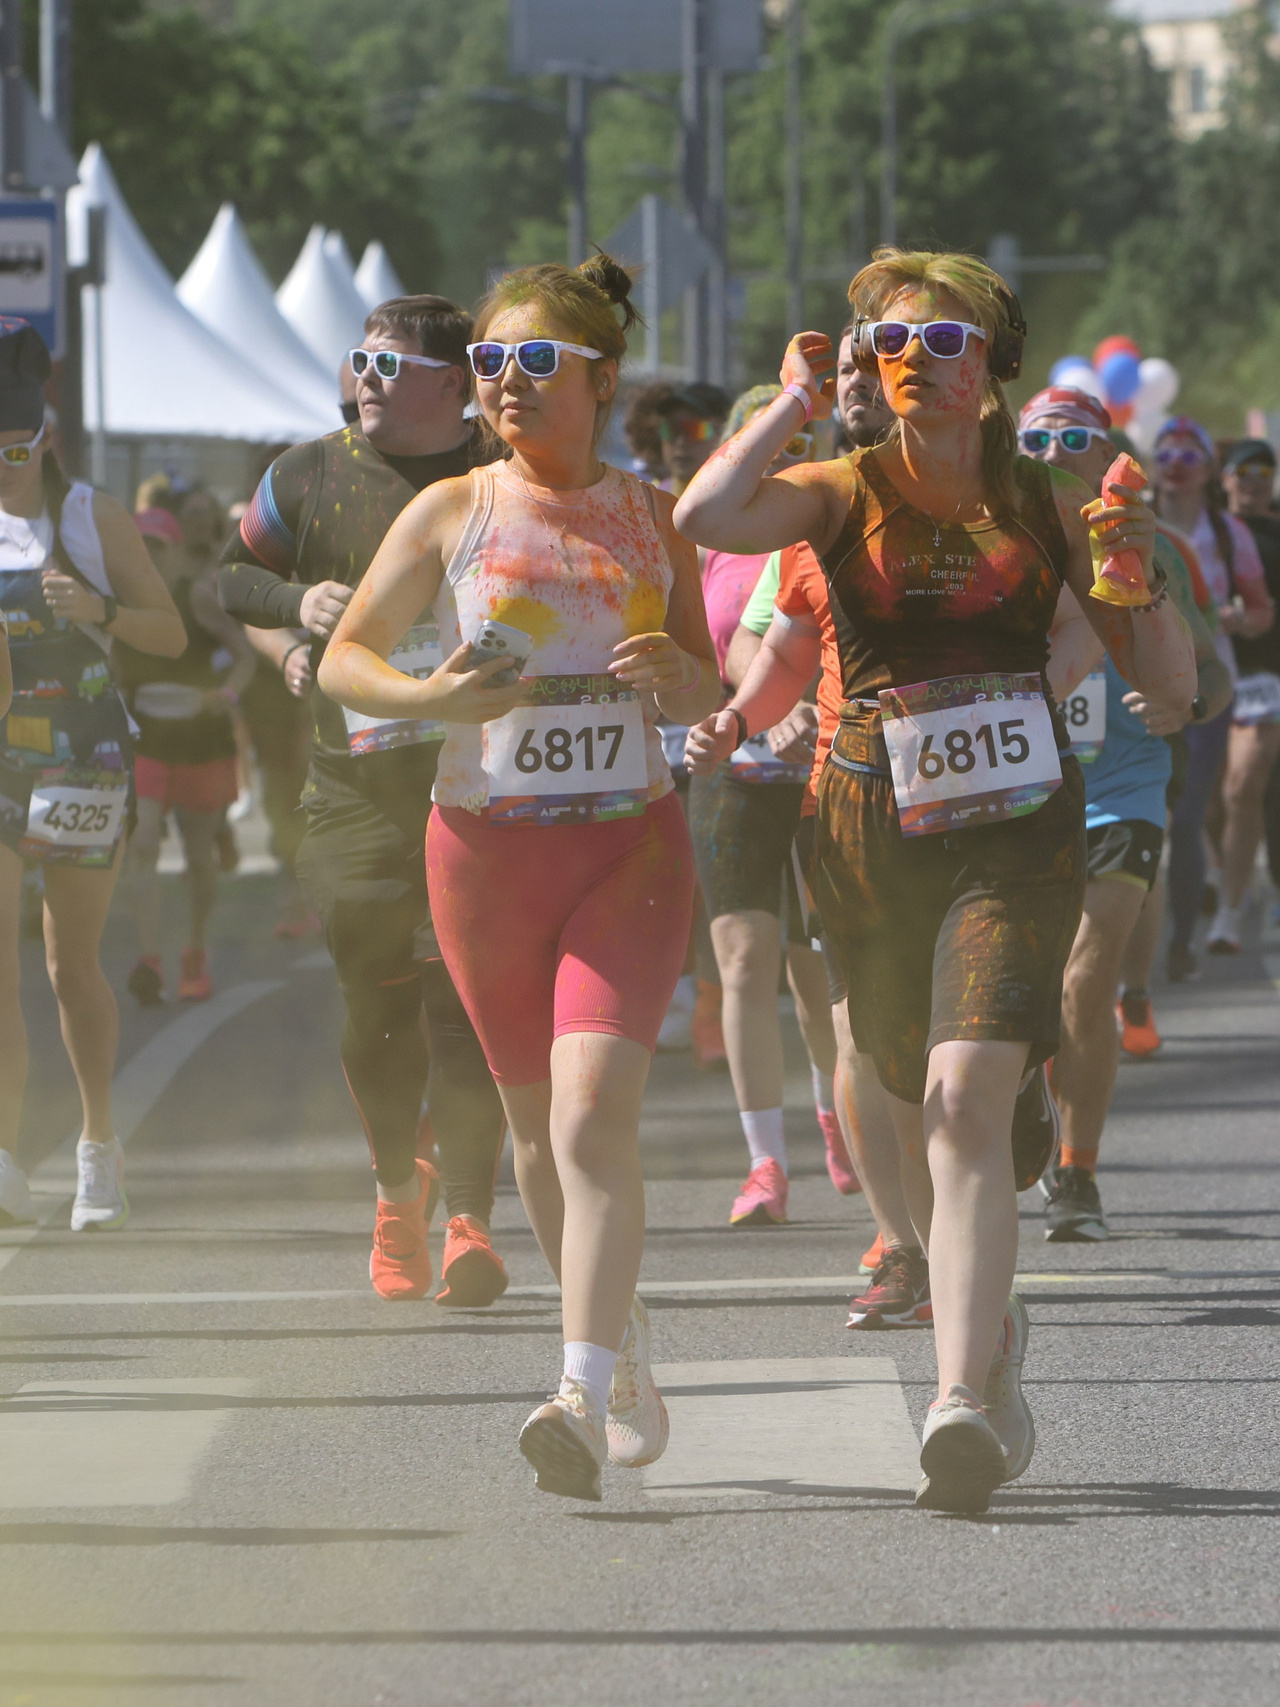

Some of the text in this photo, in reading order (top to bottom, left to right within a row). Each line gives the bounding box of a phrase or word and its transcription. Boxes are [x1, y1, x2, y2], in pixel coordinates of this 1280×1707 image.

[580, 691, 639, 706] 2026
[975, 691, 1042, 704] 2026
[514, 725, 624, 773] 6817
[917, 719, 1030, 780] 6815
[43, 801, 112, 832] 4325
